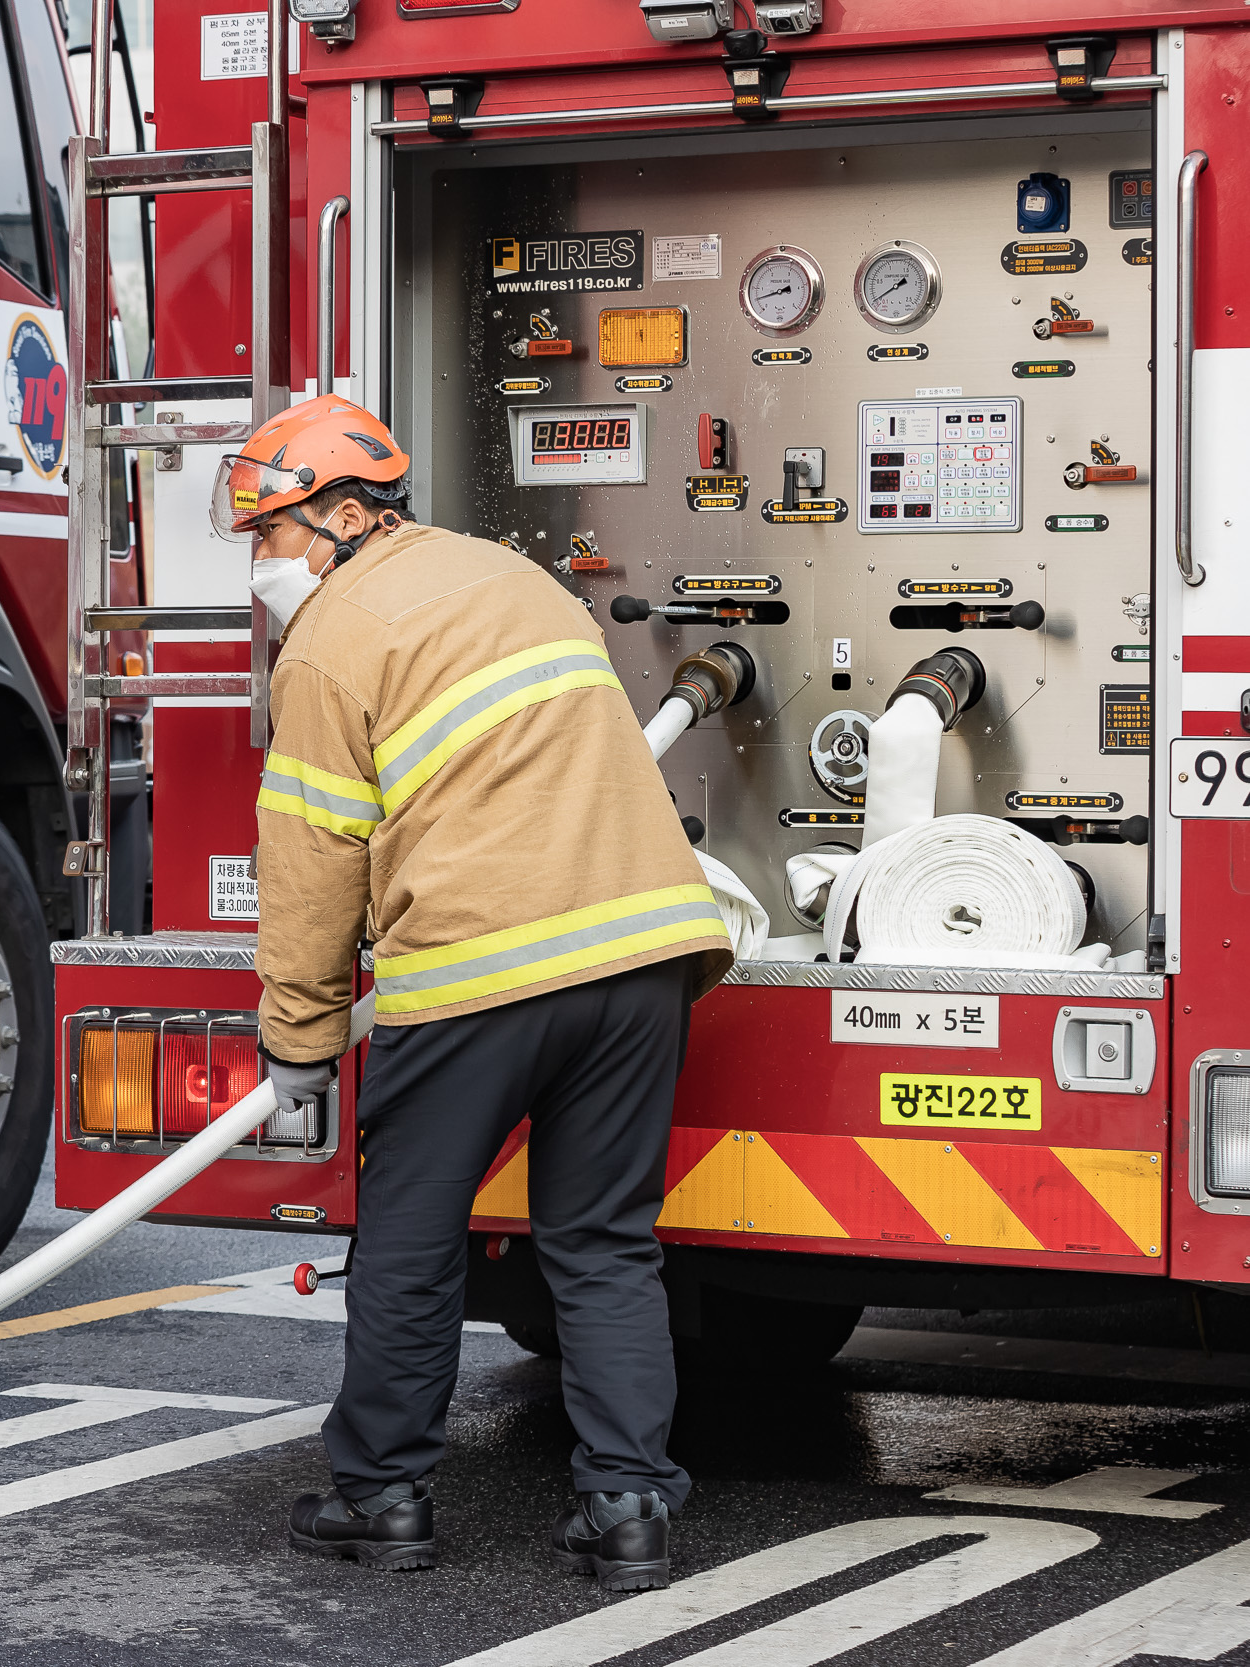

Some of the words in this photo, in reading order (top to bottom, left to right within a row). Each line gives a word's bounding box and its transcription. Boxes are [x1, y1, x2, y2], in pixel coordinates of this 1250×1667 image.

[210, 19, 239, 28] 펌프차
[221, 30, 239, 38] 65mm
[1061, 77, 1085, 85] 파이어스
[736, 96, 759, 104] 파이어스
[432, 115, 453, 123] 파이어스
[526, 237, 636, 271] FIRES
[497, 276, 632, 293] www.fires119.co.kr
[21, 363, 67, 440] 119
[881, 505, 897, 517] 63
[713, 580, 740, 589] 방수구
[941, 584, 969, 593] 방수구
[835, 642, 848, 665] 5
[1050, 796, 1078, 806] 중계구
[216, 881, 258, 896] 최대적재
[843, 1005, 902, 1030] 40mm
[944, 1006, 986, 1035] 5본
[890, 1083, 1032, 1120] 광진22호
